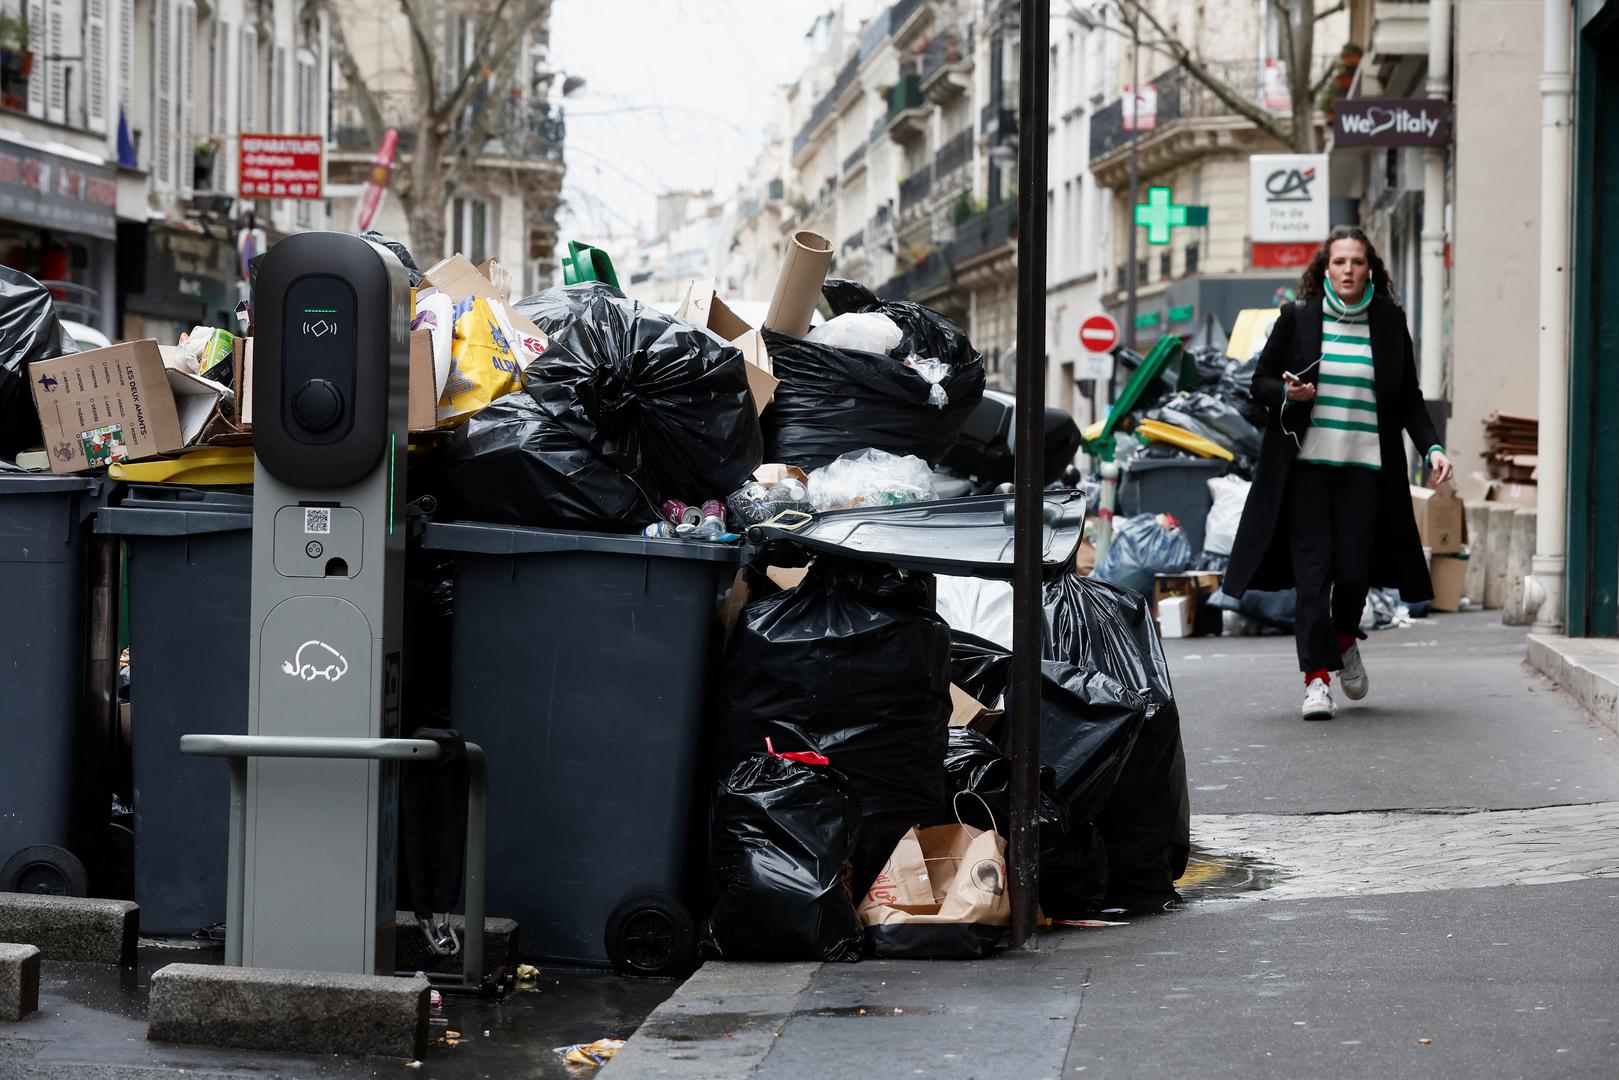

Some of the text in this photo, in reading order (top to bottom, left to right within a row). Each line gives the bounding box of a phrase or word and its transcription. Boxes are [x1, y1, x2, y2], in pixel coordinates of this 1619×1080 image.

[1342, 108, 1440, 138] We Italy
[1266, 166, 1315, 195] CA
[125, 365, 147, 435] LES DEUX AMANTS
